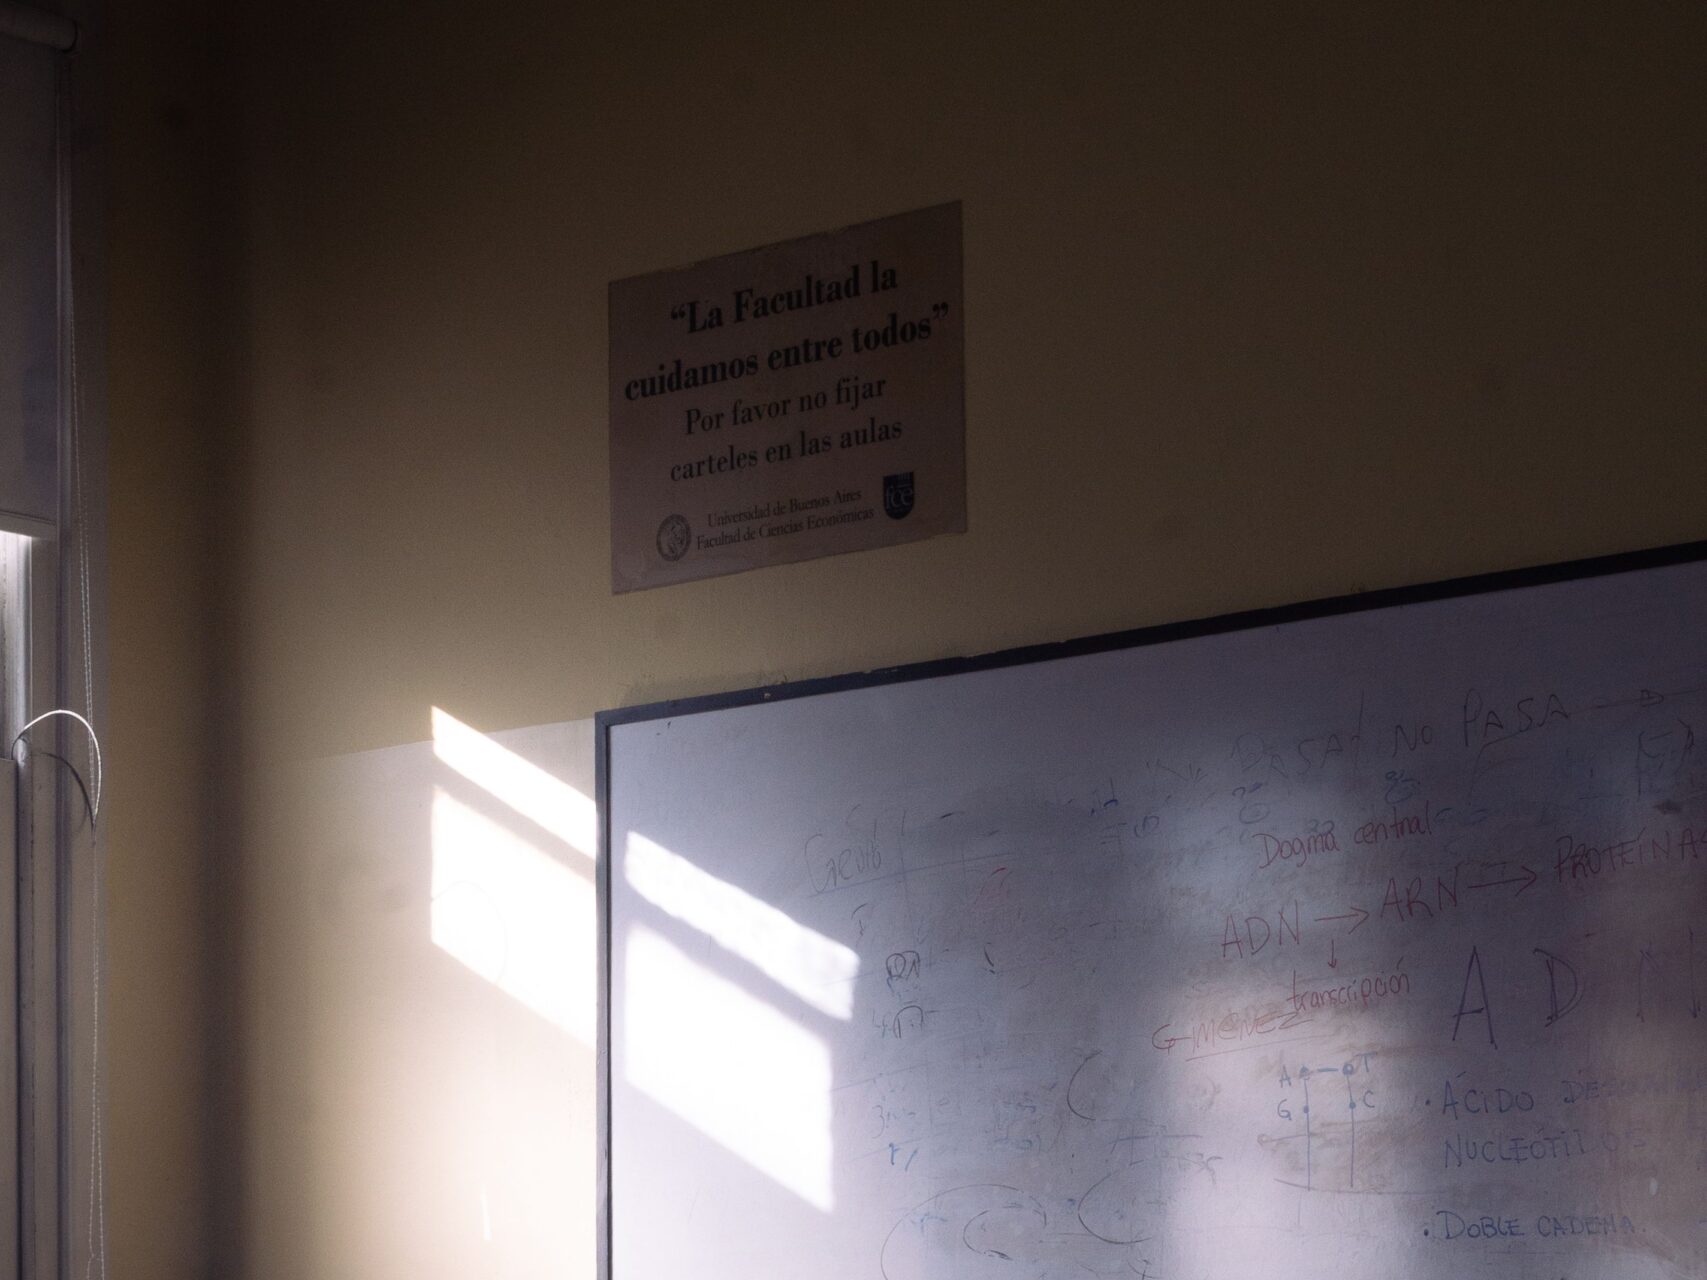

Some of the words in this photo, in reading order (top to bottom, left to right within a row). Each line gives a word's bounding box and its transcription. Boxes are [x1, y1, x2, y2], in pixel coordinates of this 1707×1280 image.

[671, 300, 722, 334] “La
[733, 265, 861, 324] Facultad
[871, 260, 898, 294] la
[625, 353, 759, 402] cuidamos
[767, 335, 842, 371] entre
[852, 302, 949, 353] todos”
[686, 408, 725, 435] Por
[732, 398, 791, 426] favor
[799, 391, 827, 413] no
[836, 376, 887, 411] fijar
[670, 446, 758, 482] carteles
[766, 442, 791, 464] en
[799, 431, 832, 458] las
[840, 417, 903, 450] aulas
[696, 529, 741, 550] Facultad
[742, 526, 757, 542] de
[758, 521, 805, 540] Ciencias
[806, 508, 875, 530] Económicas
[707, 502, 771, 529] Universidad
[773, 500, 787, 517] de
[788, 496, 831, 513] Buenos
[833, 488, 863, 505] Aires
[1462, 688, 1570, 747] PASA
[1252, 826, 1341, 870] Dogma
[1353, 800, 1434, 846] central
[1221, 901, 1302, 959] ADN
[1379, 865, 1461, 926] ARN
[1286, 958, 1410, 1015] transcripción
[1279, 1065, 1292, 1088] A
[1277, 1098, 1292, 1121] G
[1436, 1210, 1525, 1240] DOBLE
